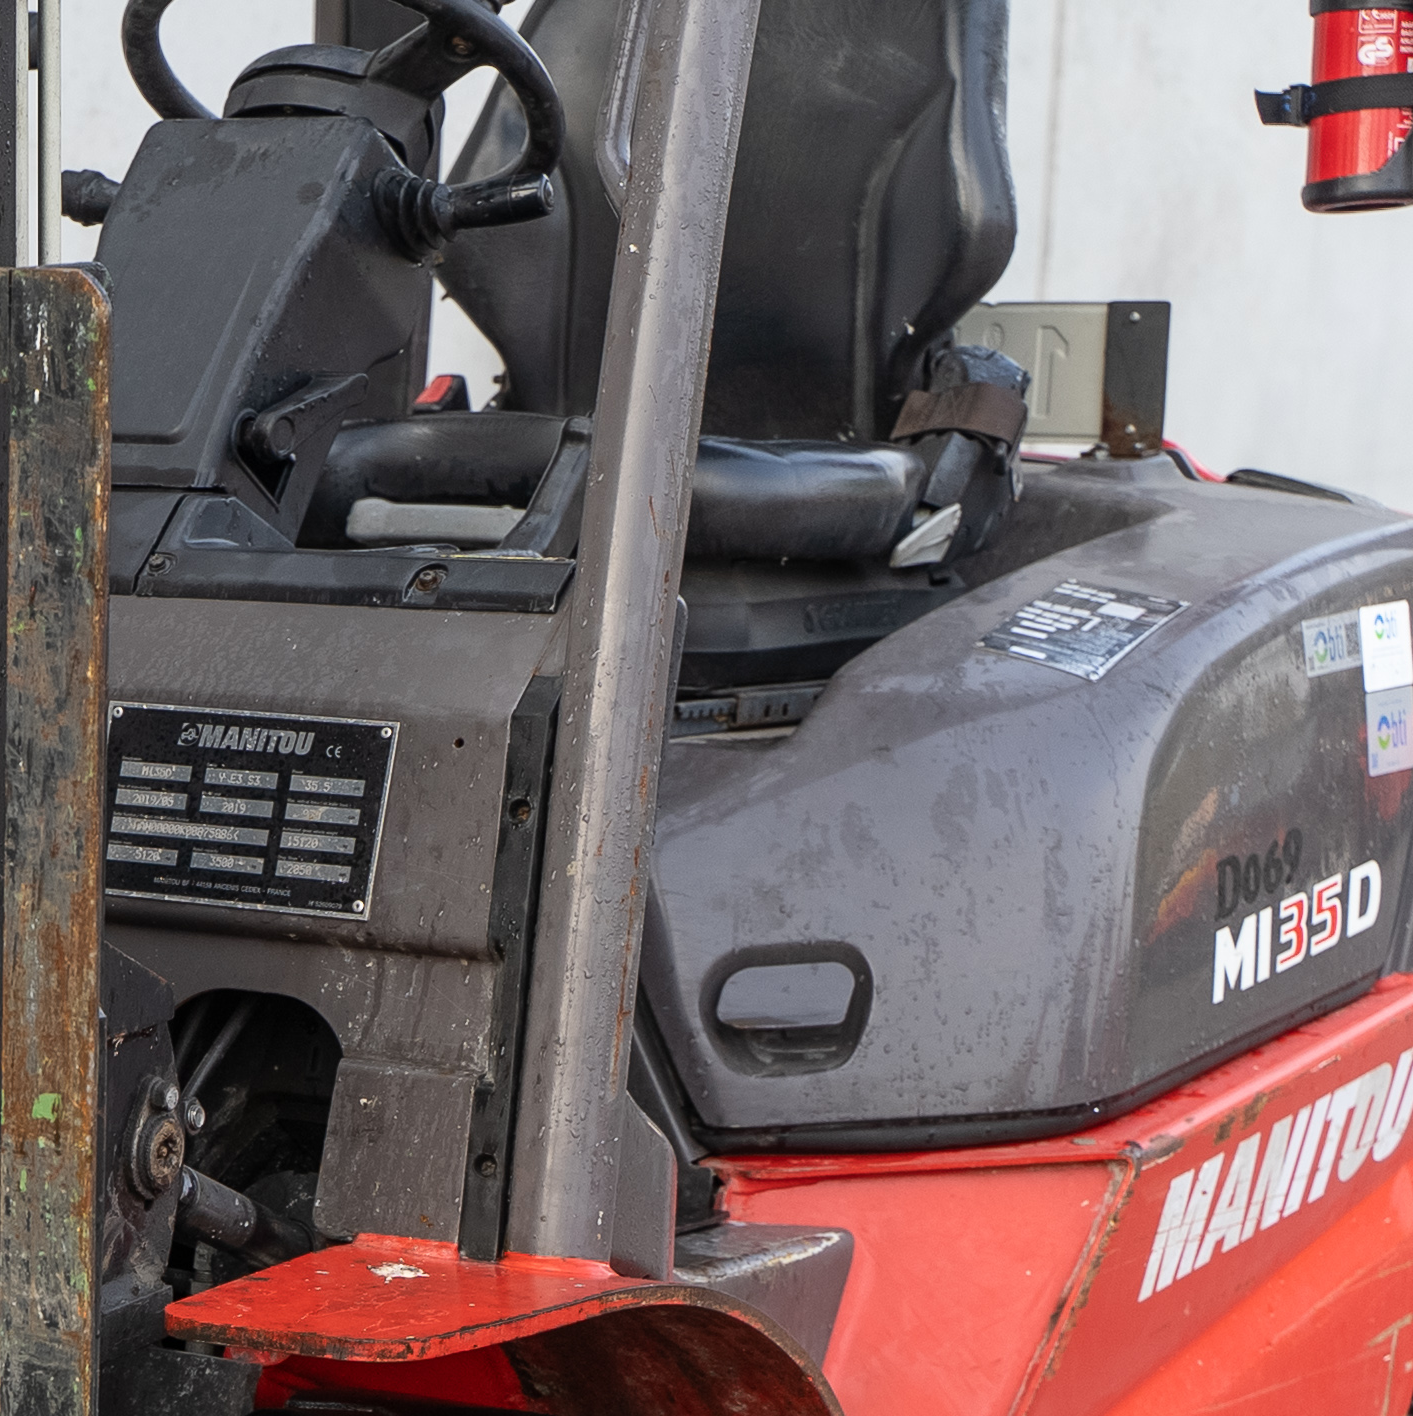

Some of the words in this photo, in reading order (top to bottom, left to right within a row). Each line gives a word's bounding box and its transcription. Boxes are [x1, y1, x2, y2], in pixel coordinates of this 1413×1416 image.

[198, 724, 315, 756] MANITOU
[222, 801, 247, 814] 2019
[209, 855, 235, 868] 3500
[1212, 859, 1382, 1005] MI35D
[1138, 1047, 1413, 1303] MANITOU
